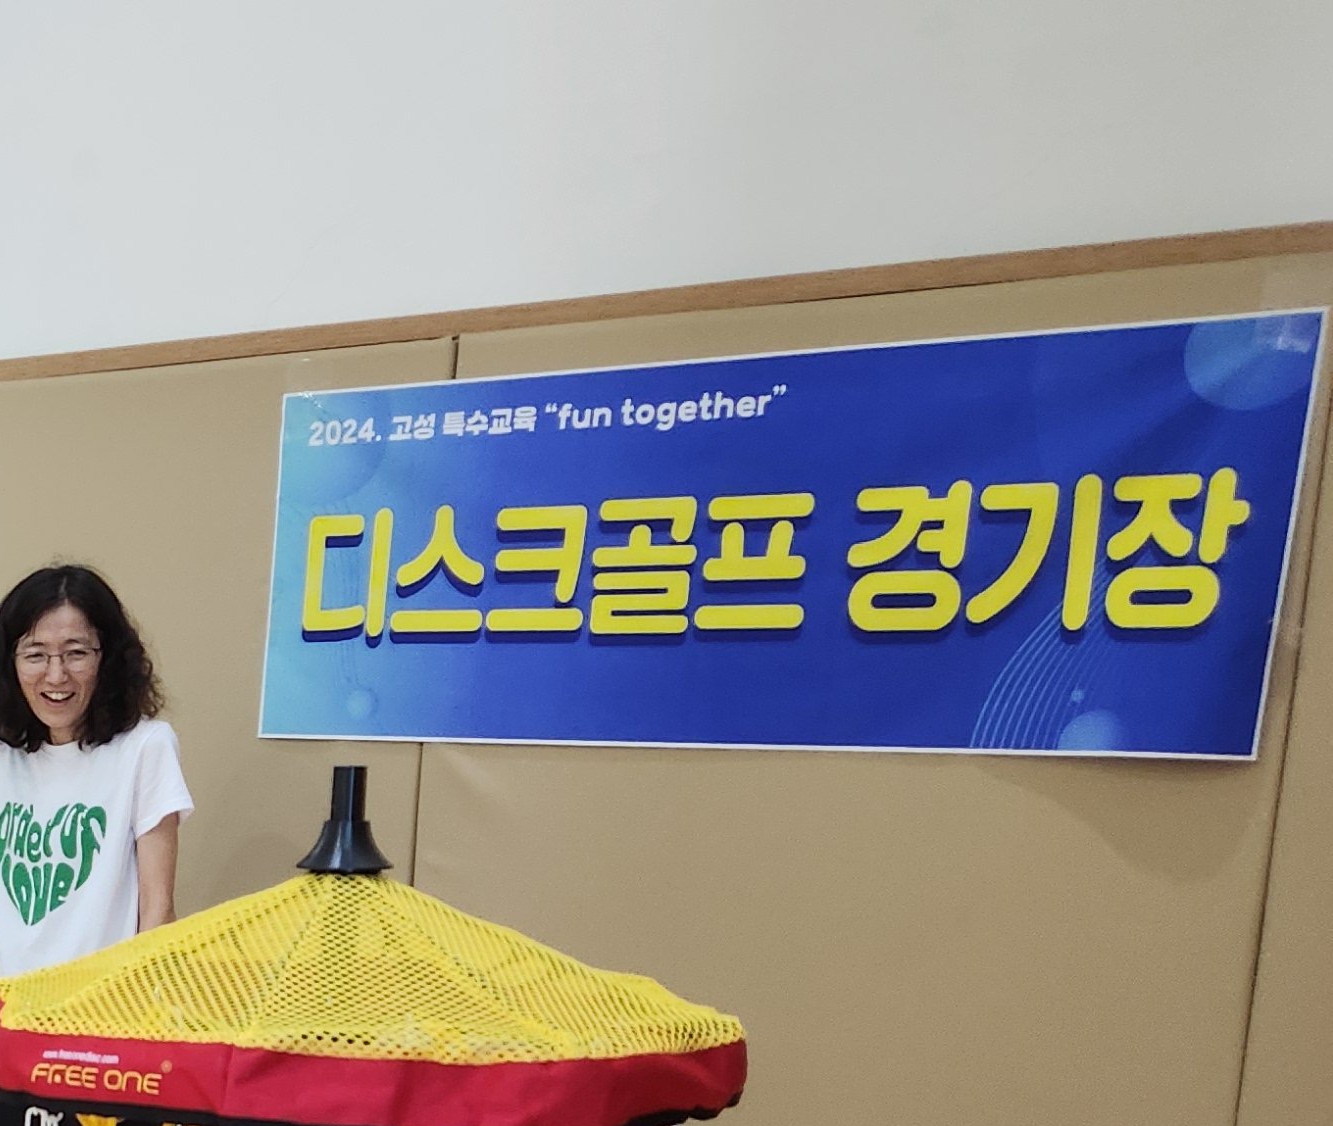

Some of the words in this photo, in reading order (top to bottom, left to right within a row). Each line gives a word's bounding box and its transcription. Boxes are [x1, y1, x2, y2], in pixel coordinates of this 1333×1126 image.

[308, 419, 382, 447] 2024.
[389, 413, 435, 441] 고성
[442, 406, 538, 437] 특수교육
[300, 492, 816, 638] 디스크골프
[846, 466, 1250, 633] 경기장
[31, 1063, 99, 1089] FREE
